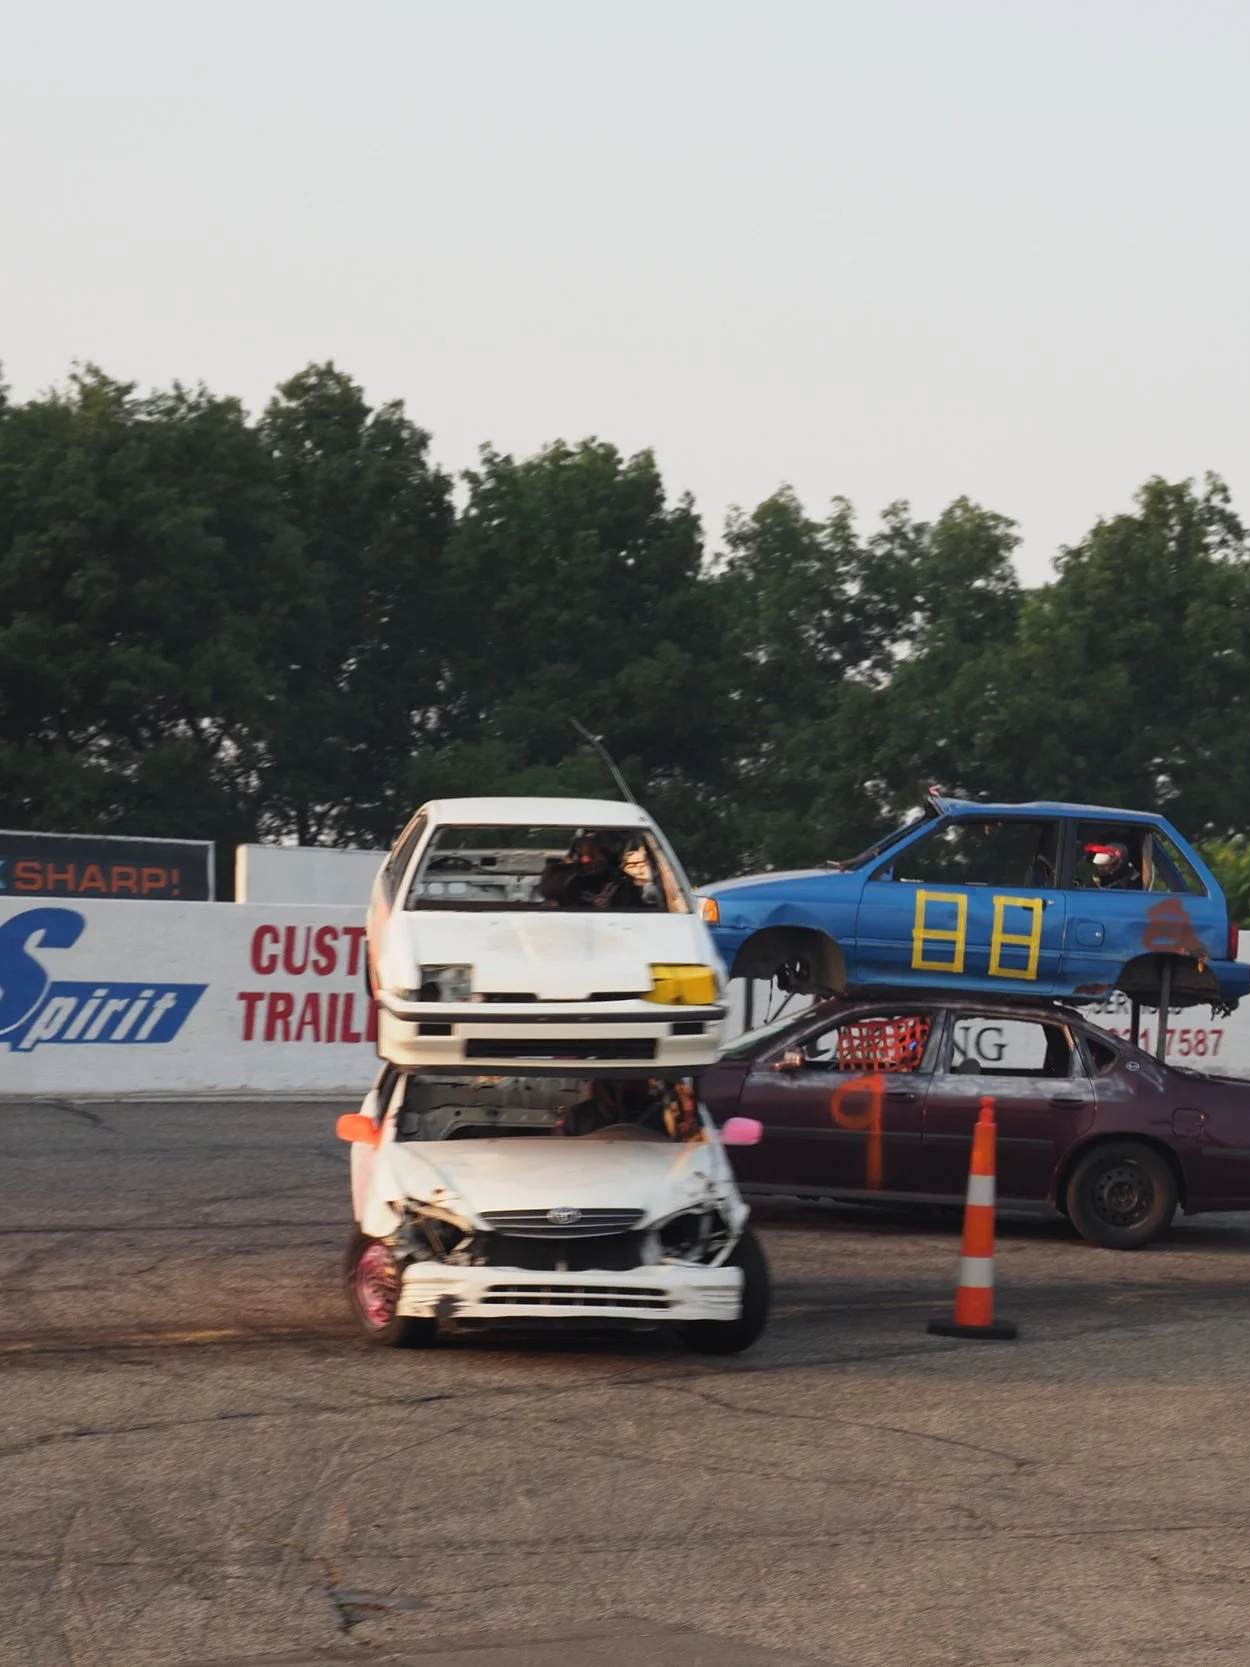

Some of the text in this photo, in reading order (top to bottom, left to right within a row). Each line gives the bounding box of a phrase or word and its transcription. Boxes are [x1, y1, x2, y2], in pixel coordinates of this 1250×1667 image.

[15, 861, 181, 895] SHARP!
[0, 907, 180, 1050] Spirit
[832, 1074, 885, 1190] 9
